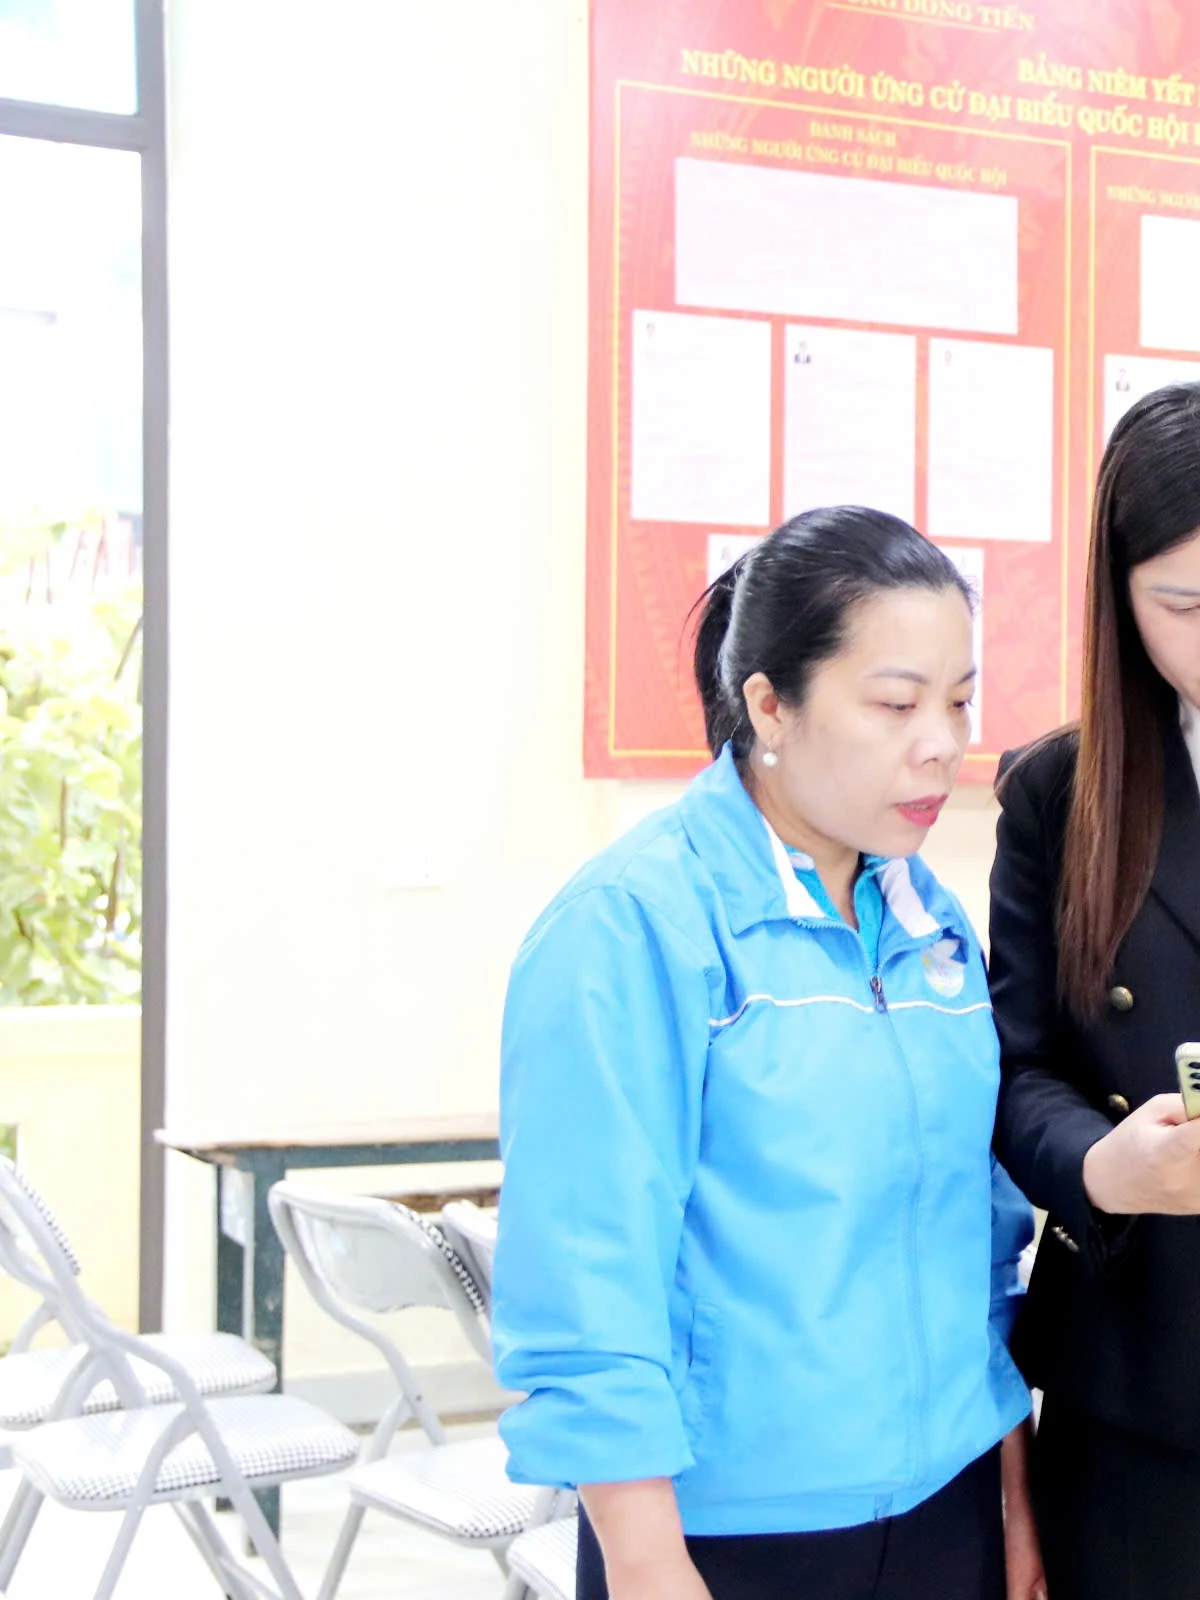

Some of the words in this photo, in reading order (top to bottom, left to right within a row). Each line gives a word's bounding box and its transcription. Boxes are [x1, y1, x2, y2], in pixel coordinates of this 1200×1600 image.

[978, 5, 1036, 31] TIẾN
[1019, 54, 1082, 89] BẢNG
[1088, 67, 1146, 100] NIÊM
[1151, 76, 1195, 106] YẾT
[681, 49, 777, 86] NHỮNG
[783, 64, 866, 98] NGƯỜI
[872, 71, 924, 107] ỨNG
[931, 80, 966, 111] CỬ
[970, 93, 1010, 123] ĐẠI
[1017, 91, 1073, 127] BIỂU
[1078, 104, 1142, 139] QUỐC
[1147, 119, 1188, 149] HỘI
[690, 131, 748, 153] NHỮNG
[752, 138, 803, 161] NGƯỜI
[806, 145, 839, 165] ỨNG
[810, 121, 854, 143] DANH
